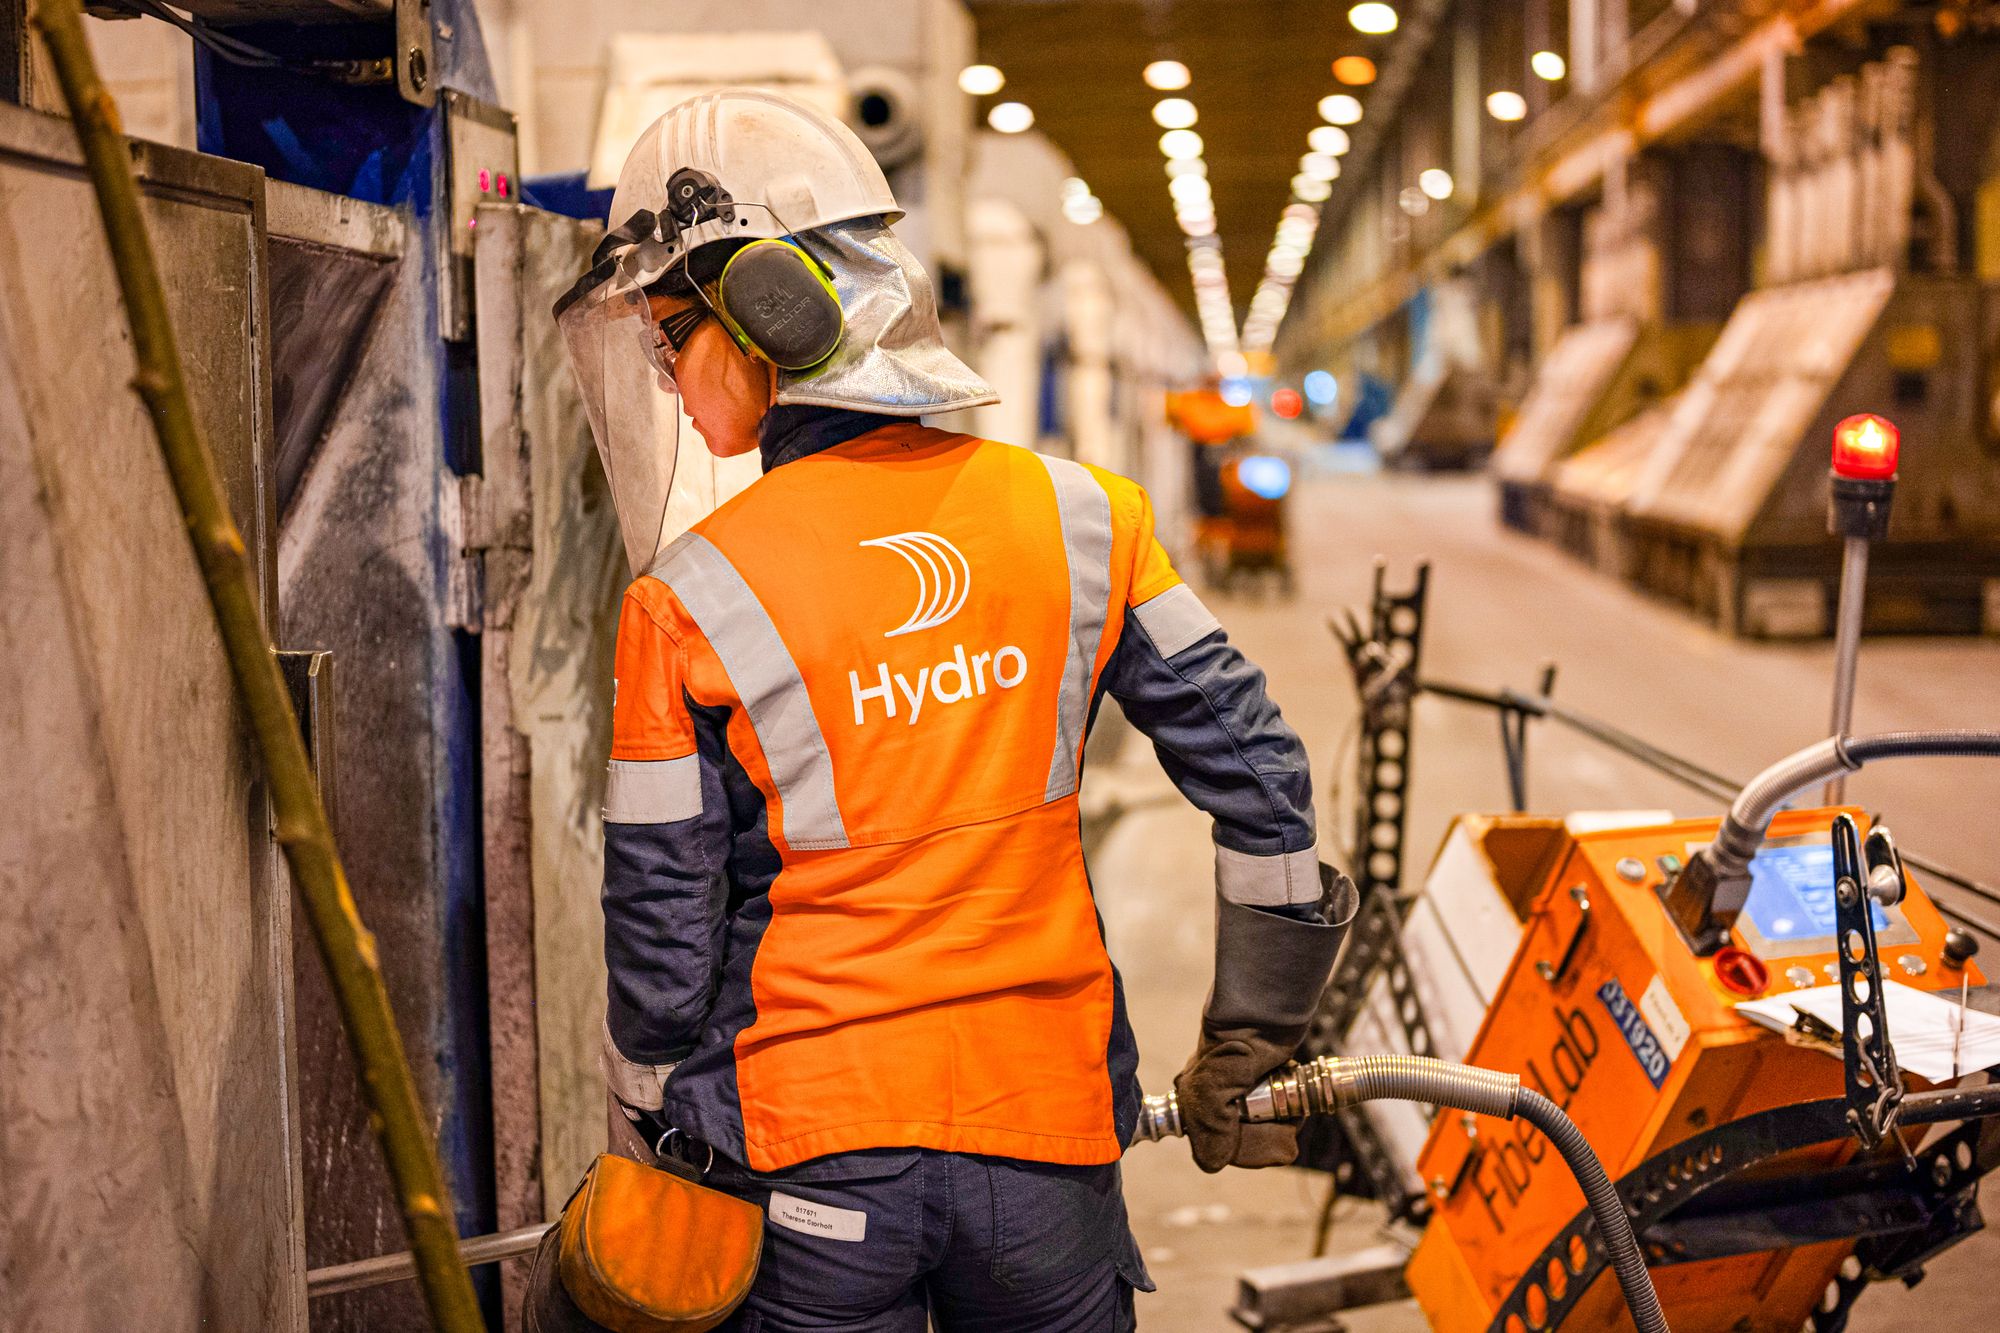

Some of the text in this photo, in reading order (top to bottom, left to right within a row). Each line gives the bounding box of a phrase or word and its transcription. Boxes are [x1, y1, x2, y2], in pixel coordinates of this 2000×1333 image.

[755, 285, 794, 319] 3M
[766, 296, 811, 336] PELTOR
[848, 643, 1028, 726] Hydro
[1472, 1005, 1599, 1234] FibeLab
